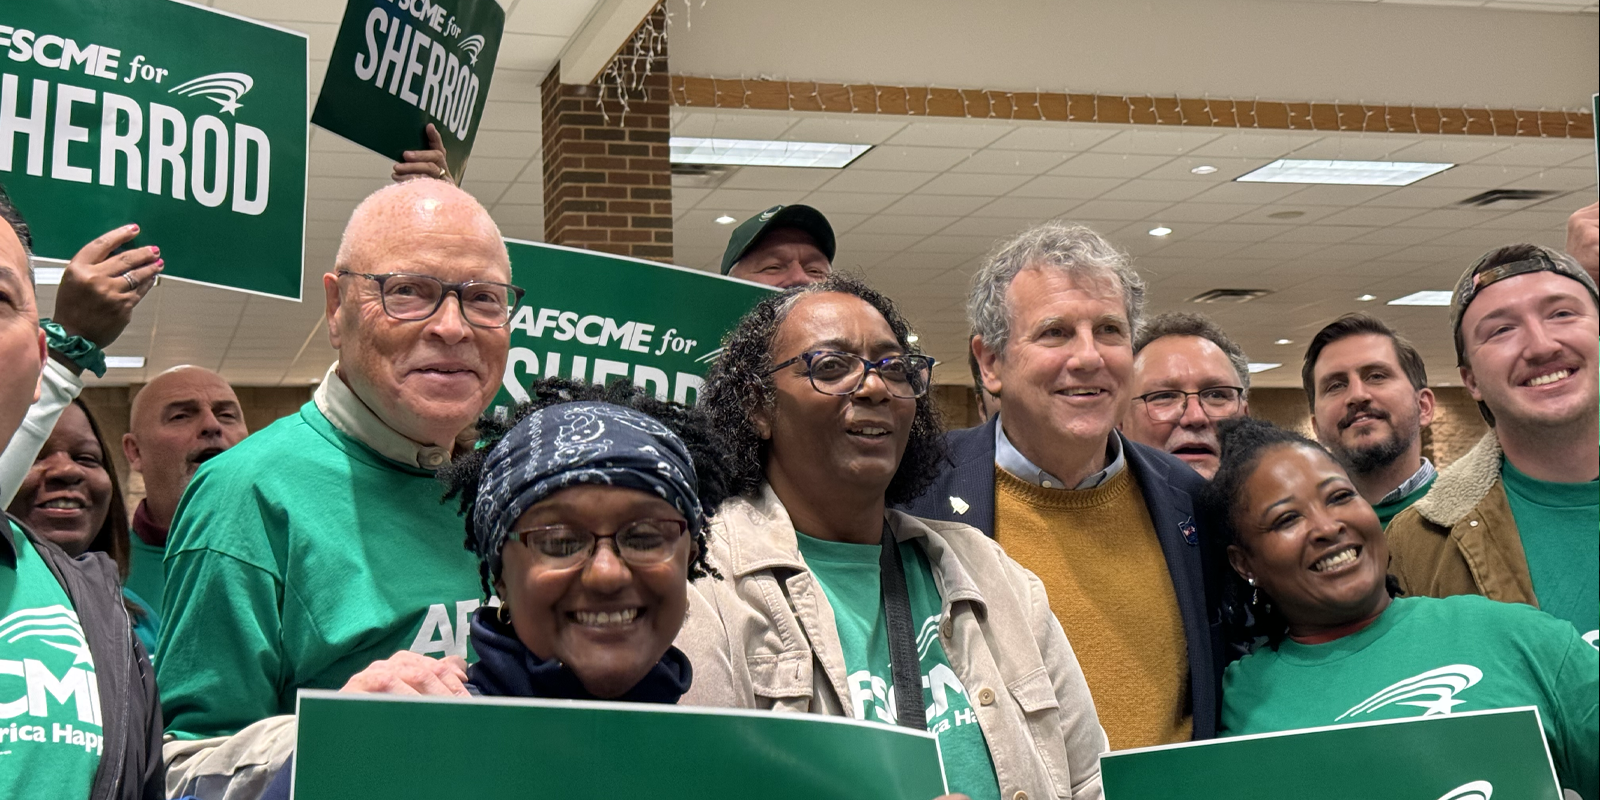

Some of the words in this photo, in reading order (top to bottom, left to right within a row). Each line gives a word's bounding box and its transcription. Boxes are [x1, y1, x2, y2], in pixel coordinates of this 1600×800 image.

[443, 16, 462, 39] for
[124, 55, 169, 83] for
[354, 6, 480, 142] SHERROD
[0, 73, 271, 216] HERROD
[508, 305, 655, 353] AFSCME
[655, 328, 697, 356] for
